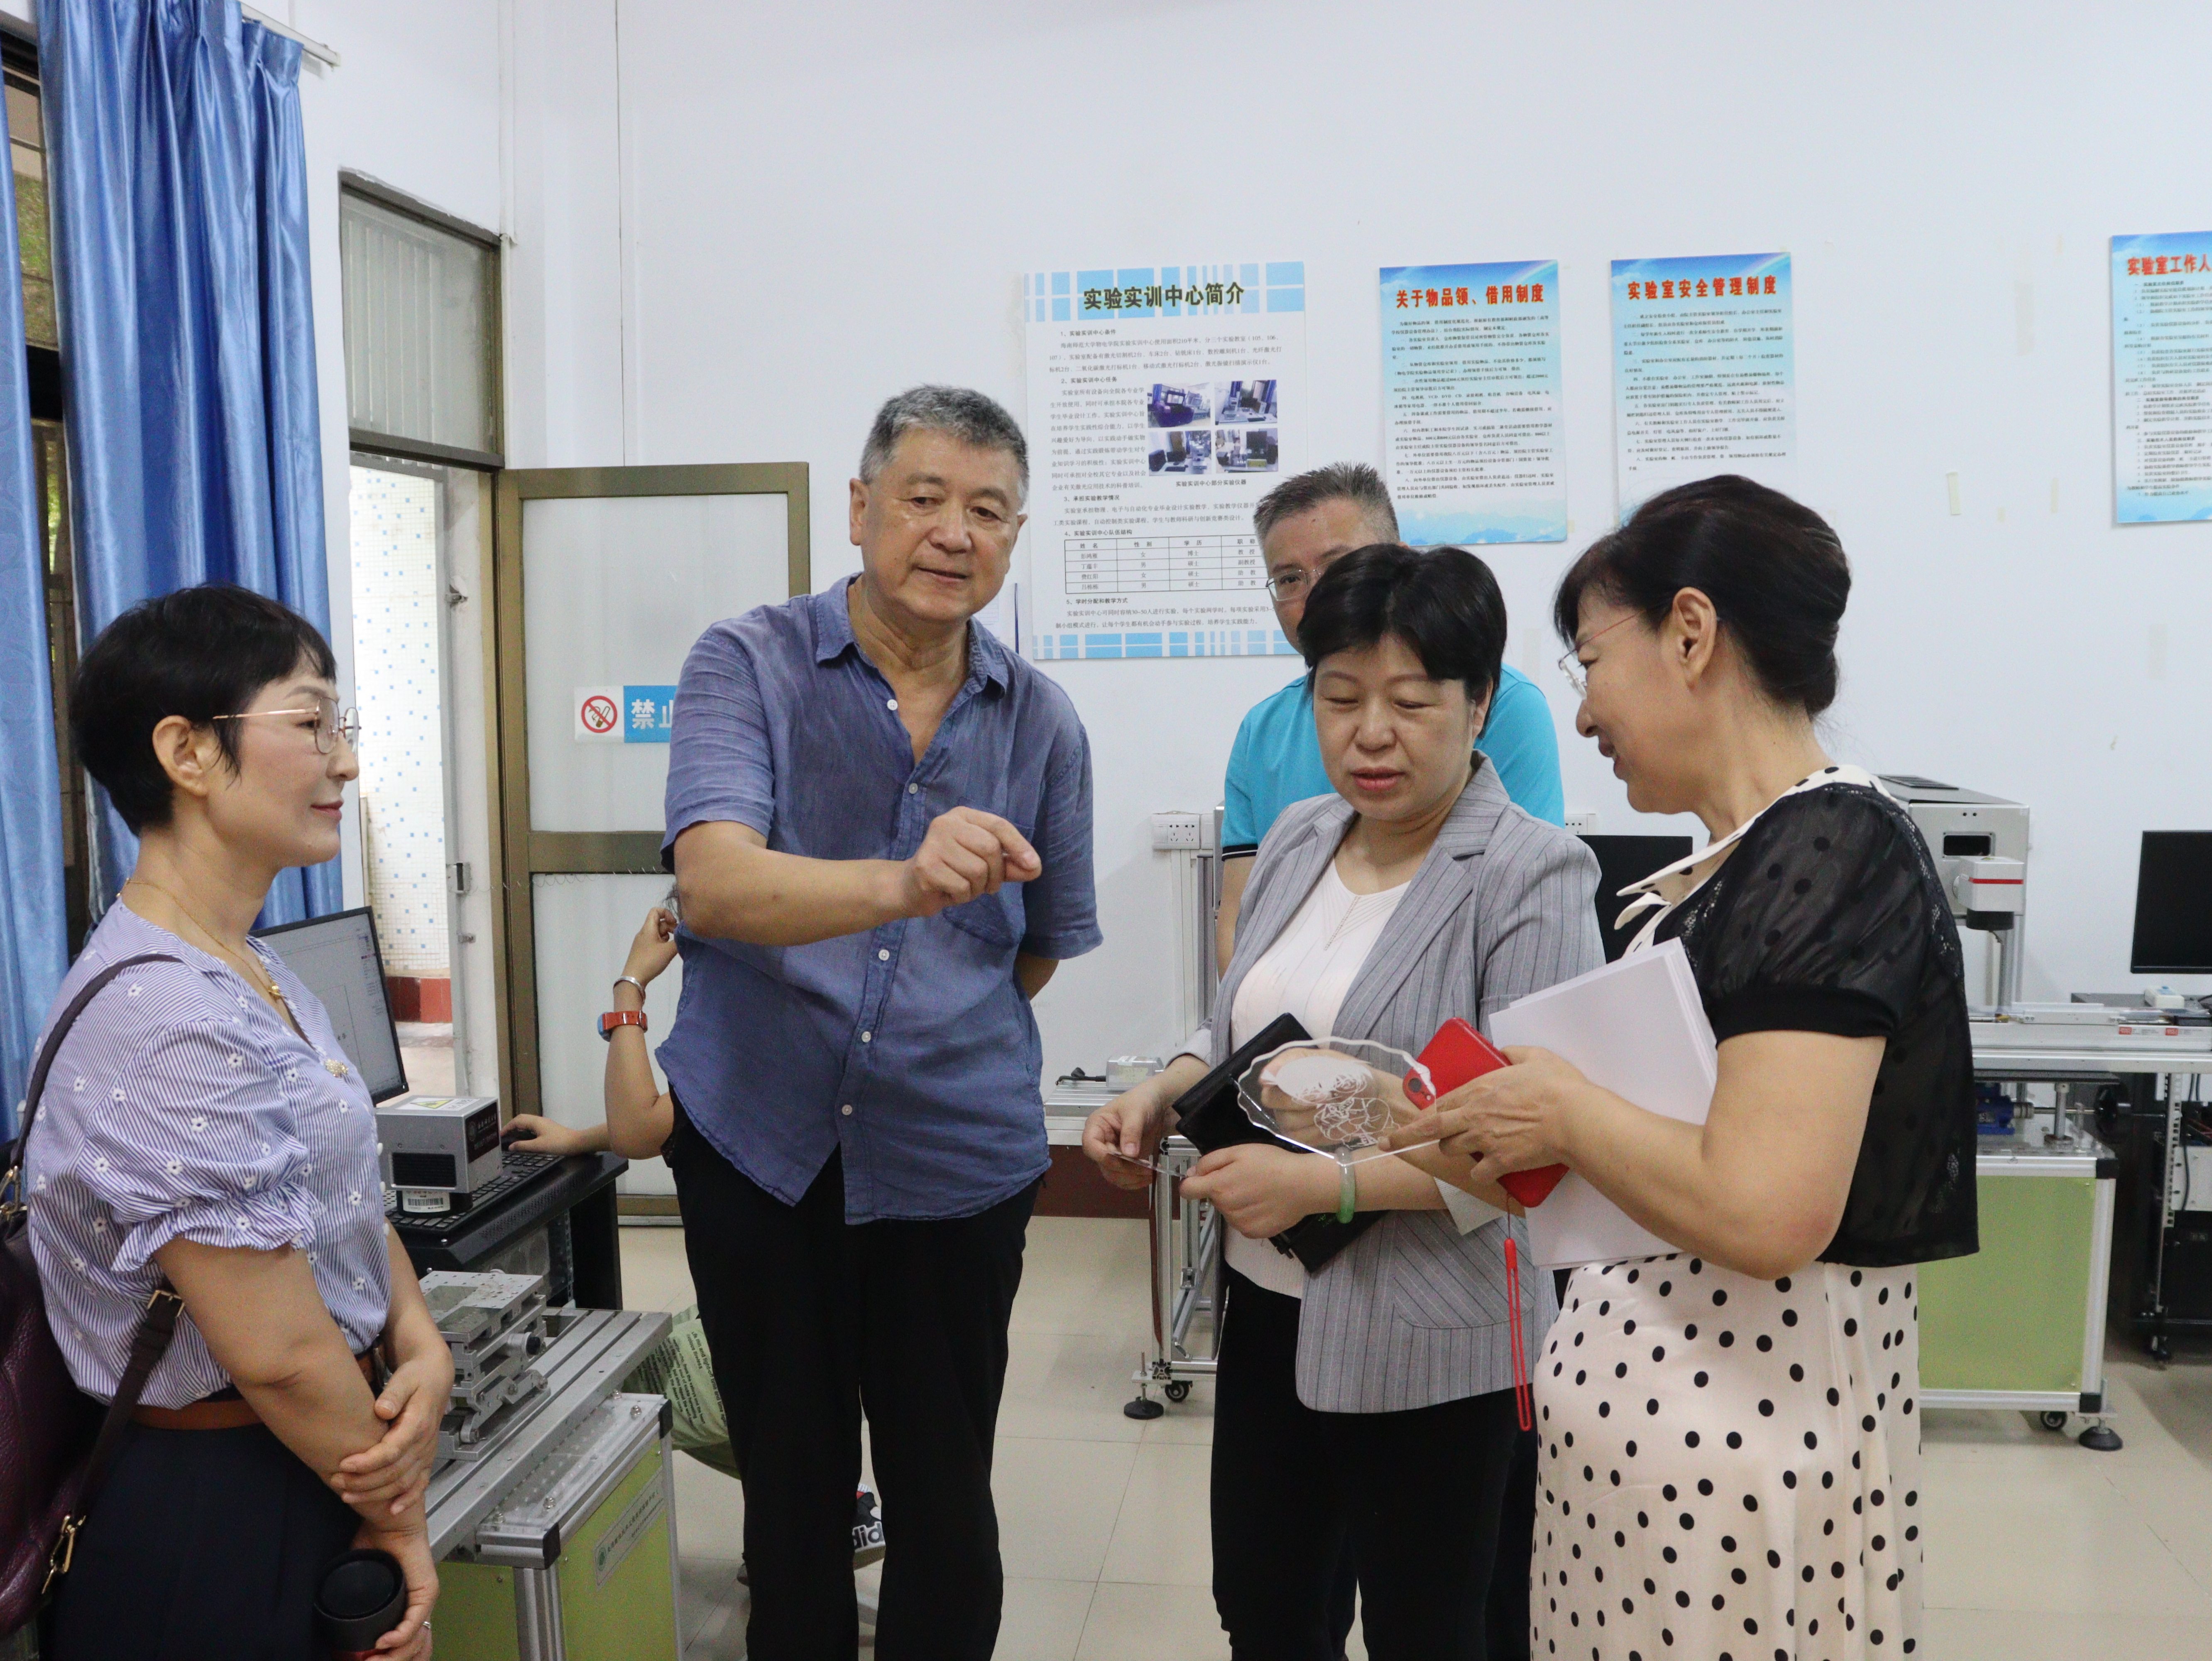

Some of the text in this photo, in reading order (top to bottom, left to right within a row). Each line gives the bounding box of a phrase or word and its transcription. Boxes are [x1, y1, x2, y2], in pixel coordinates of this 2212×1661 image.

[2127, 253, 2212, 276] 实验室工作人
[1083, 281, 1245, 310] 实验实训中心简介
[1396, 283, 1544, 309] 关于物品领、借用制度
[1628, 274, 1776, 300] 实验室安全管理制度
